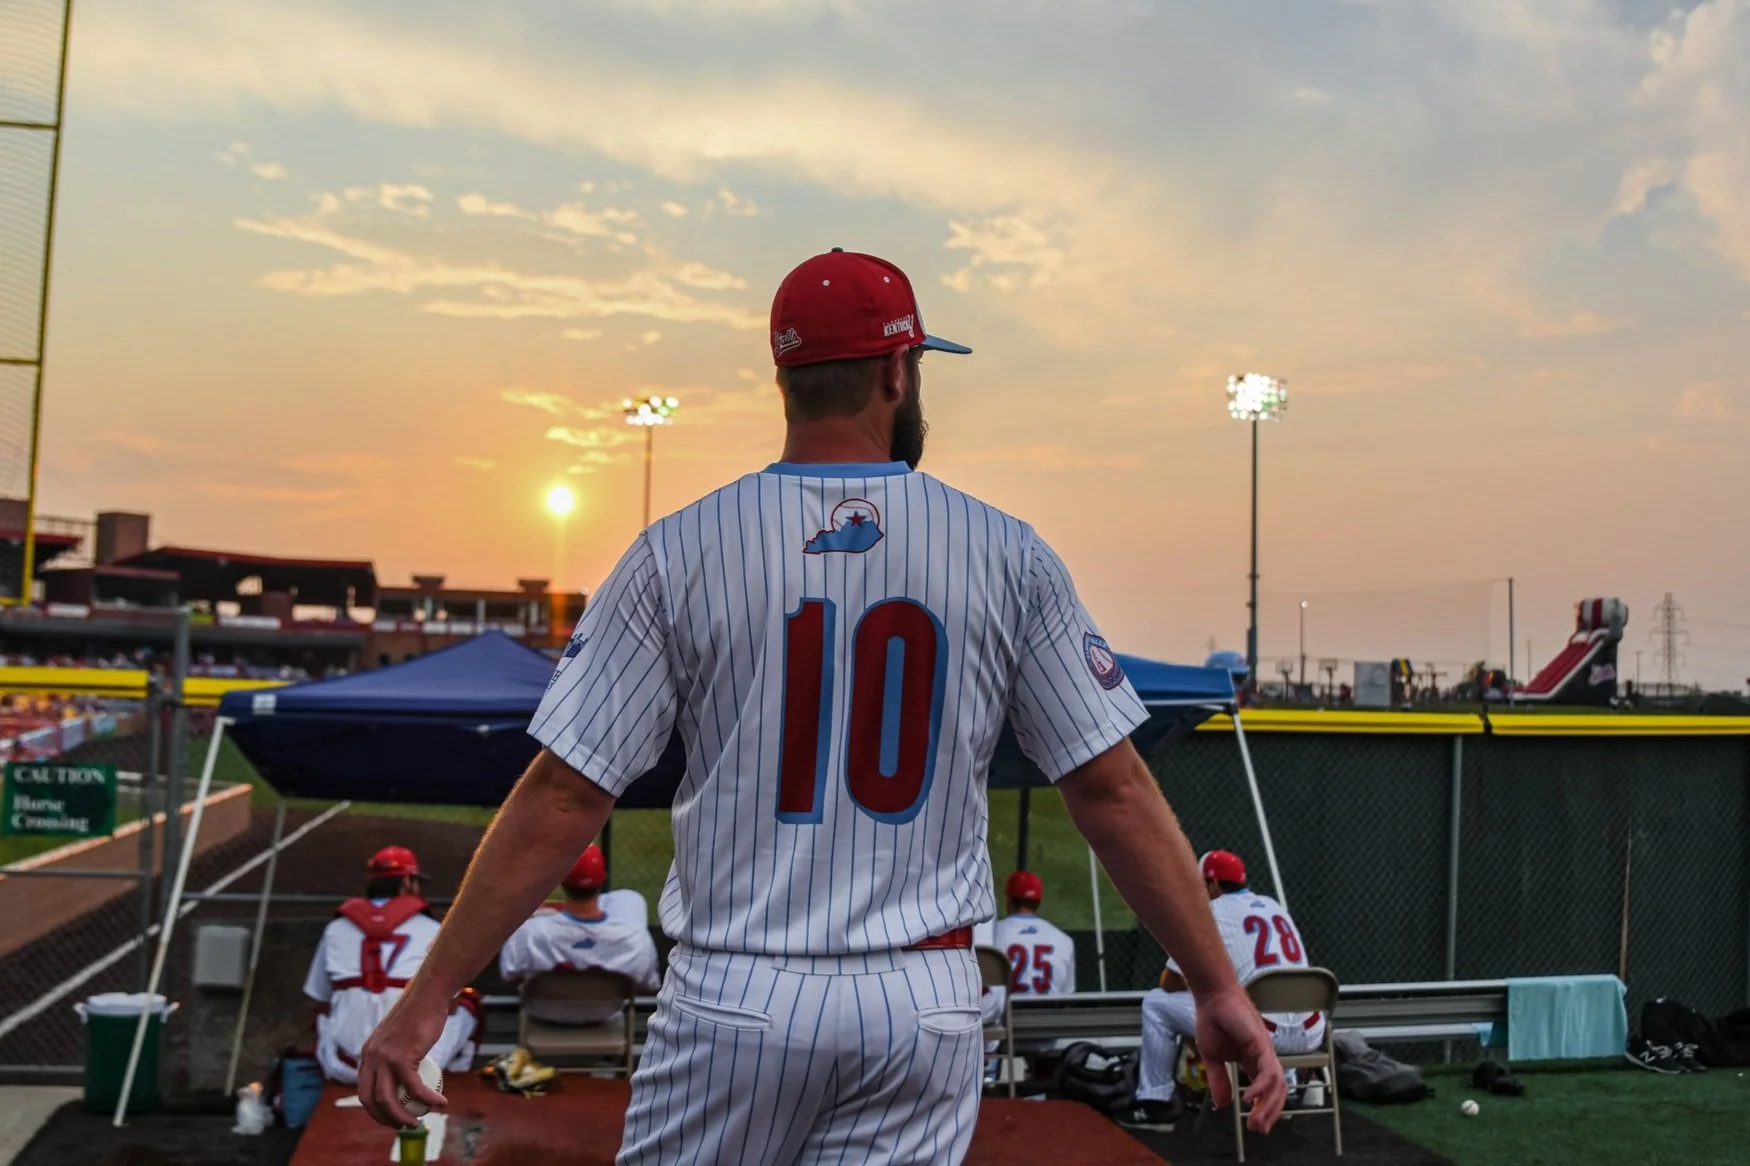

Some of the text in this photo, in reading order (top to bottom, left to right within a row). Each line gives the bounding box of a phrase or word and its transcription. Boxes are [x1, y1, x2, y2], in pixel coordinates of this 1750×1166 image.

[775, 596, 949, 825] 10
[14, 766, 106, 785] CAUTION
[13, 794, 65, 812] Horse
[11, 813, 89, 832] Crossing
[1243, 914, 1302, 968] 28
[1007, 943, 1054, 994] 25
